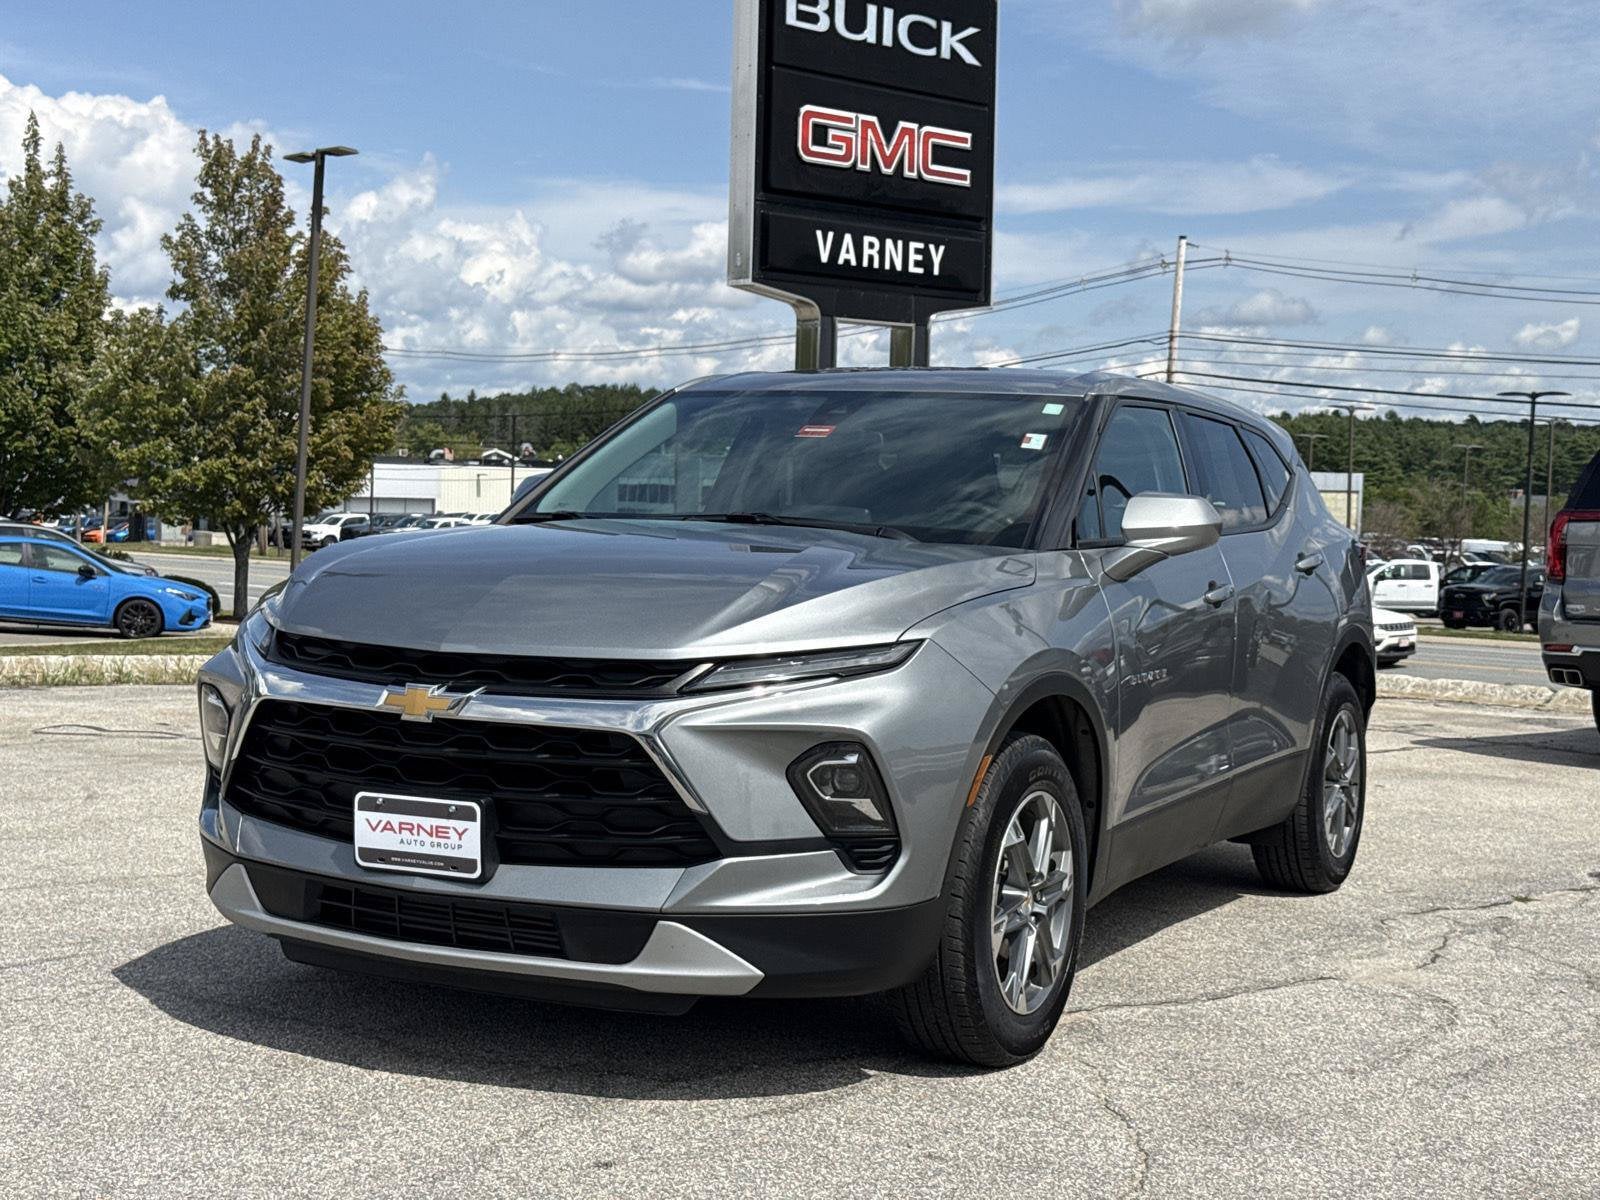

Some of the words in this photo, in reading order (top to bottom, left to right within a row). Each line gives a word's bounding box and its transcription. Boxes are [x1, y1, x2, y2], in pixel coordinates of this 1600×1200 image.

[785, 0, 982, 67] BUICK
[798, 104, 972, 187] GMC
[815, 229, 945, 276] VARNEY
[365, 818, 469, 841] VARNEY
[399, 838, 426, 847] AUTO
[430, 842, 463, 850] GROUP
